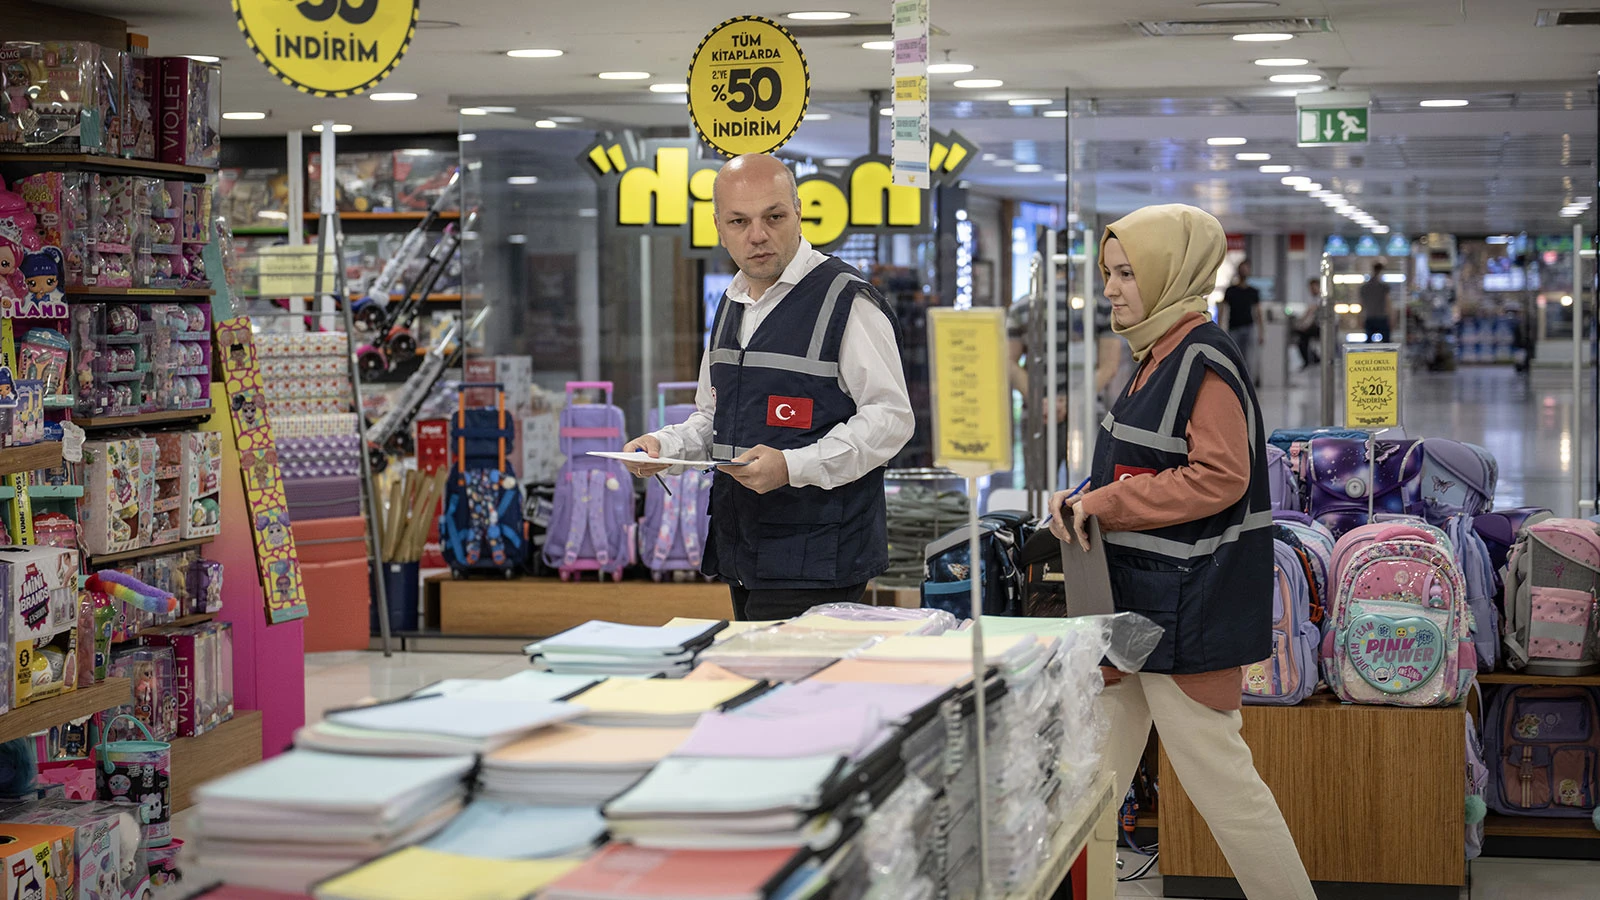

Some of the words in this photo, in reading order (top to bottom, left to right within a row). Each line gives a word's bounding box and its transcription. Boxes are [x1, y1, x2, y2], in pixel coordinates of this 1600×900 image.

[275, 28, 378, 62] İNDİRİM
[732, 32, 761, 47] TÜM
[712, 48, 781, 62] KİTAPLARDA
[163, 72, 180, 150] VIOLET
[713, 117, 781, 138] İNDİRİM
[1360, 384, 1384, 396] %20
[20, 587, 49, 613] BRANDS
[1352, 621, 1375, 640] TEAM
[1365, 637, 1417, 654] PINK
[1350, 642, 1370, 672] DREAM
[1371, 647, 1435, 664] POWER
[35, 846, 50, 863] SERIES
[42, 860, 50, 879] 2
